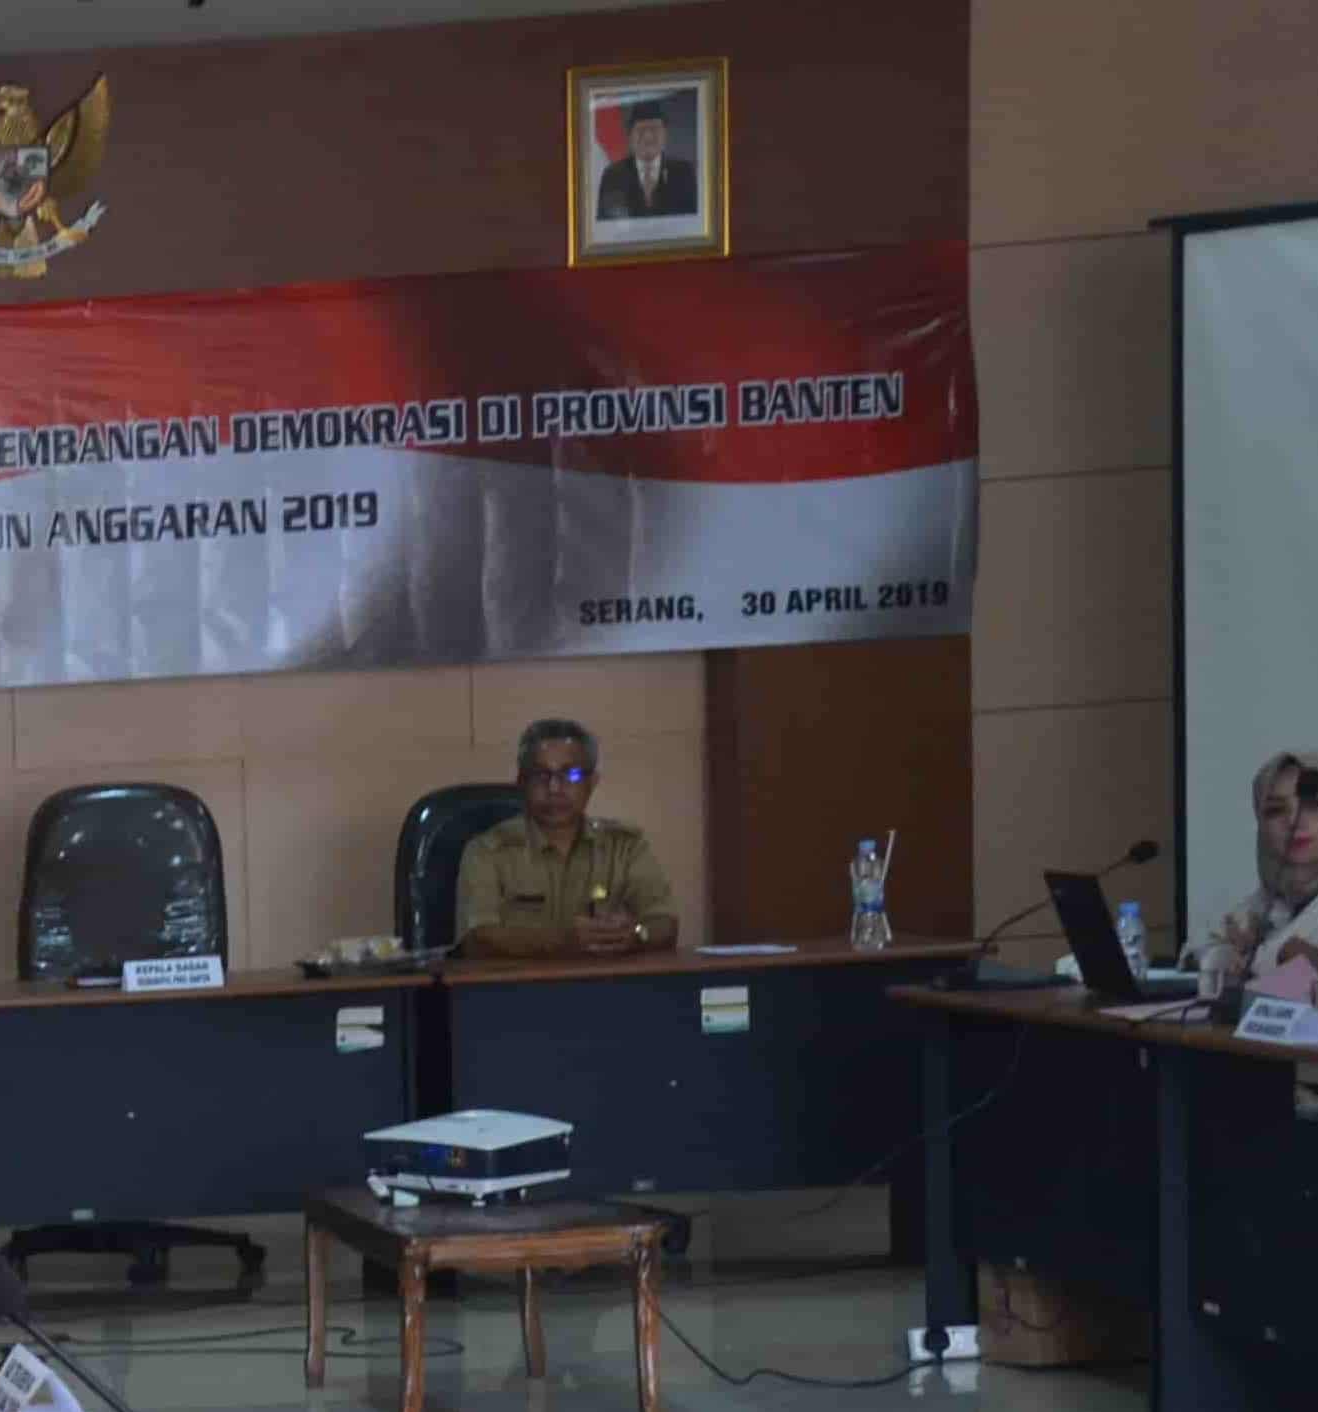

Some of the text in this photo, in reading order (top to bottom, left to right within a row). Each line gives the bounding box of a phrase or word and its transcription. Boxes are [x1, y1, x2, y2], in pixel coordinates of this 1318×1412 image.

[230, 399, 466, 456] DEMOKRASI
[479, 393, 521, 443] DI
[532, 380, 727, 440] PROVINSI
[738, 371, 903, 426] BANTEN
[46, 498, 267, 549] ANGGARAN
[282, 489, 379, 533] 2019
[578, 579, 949, 627] SERANG, 30 APRIL 2019
